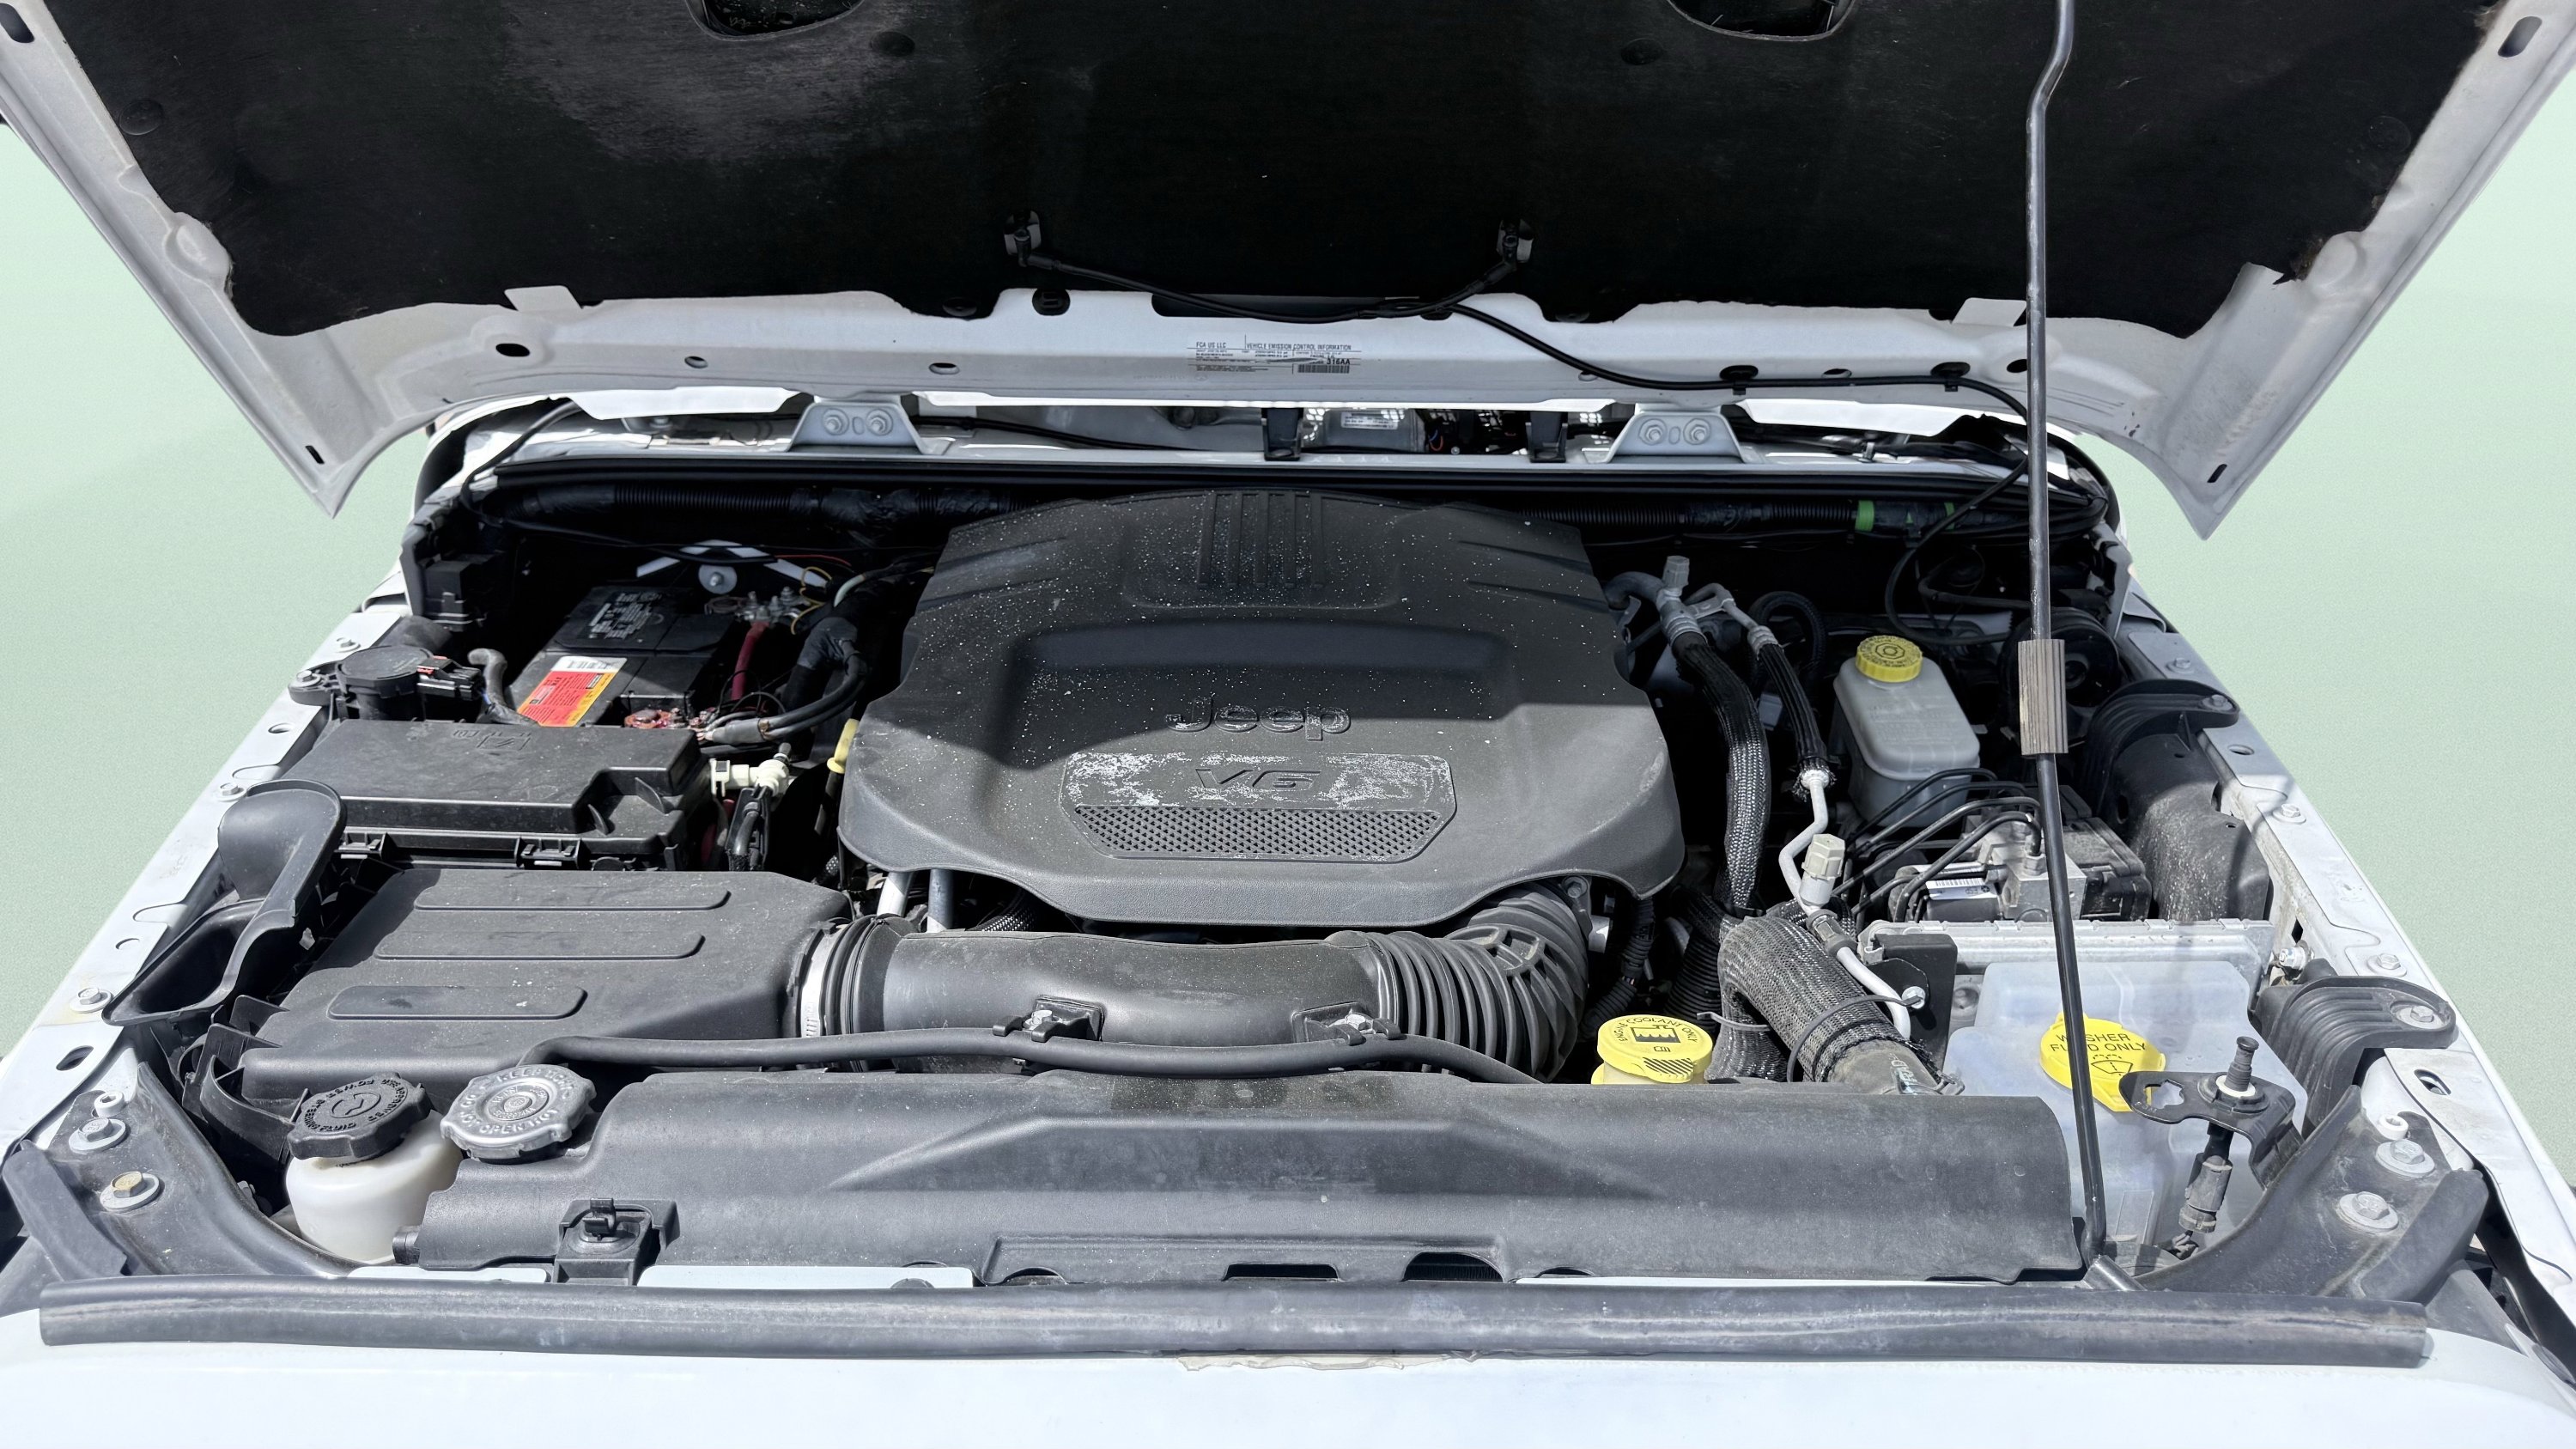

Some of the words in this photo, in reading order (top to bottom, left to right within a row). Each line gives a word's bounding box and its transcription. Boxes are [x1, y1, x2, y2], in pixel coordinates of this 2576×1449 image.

[1165, 697, 1352, 742] Jeep
[1195, 768, 1322, 790] V6
[1614, 1022, 1629, 1043] ENGINE
[1625, 1017, 1682, 1028] COOLANT
[1681, 1027, 1699, 1044] ONLY
[2056, 1033, 2131, 1042] WSHER
[2105, 1042, 2147, 1050] ONLY
[495, 1067, 543, 1083] KEEP
[319, 1122, 357, 1133] FLUID
[478, 1123, 526, 1135] OPEN
[526, 1108, 559, 1128] HOT
